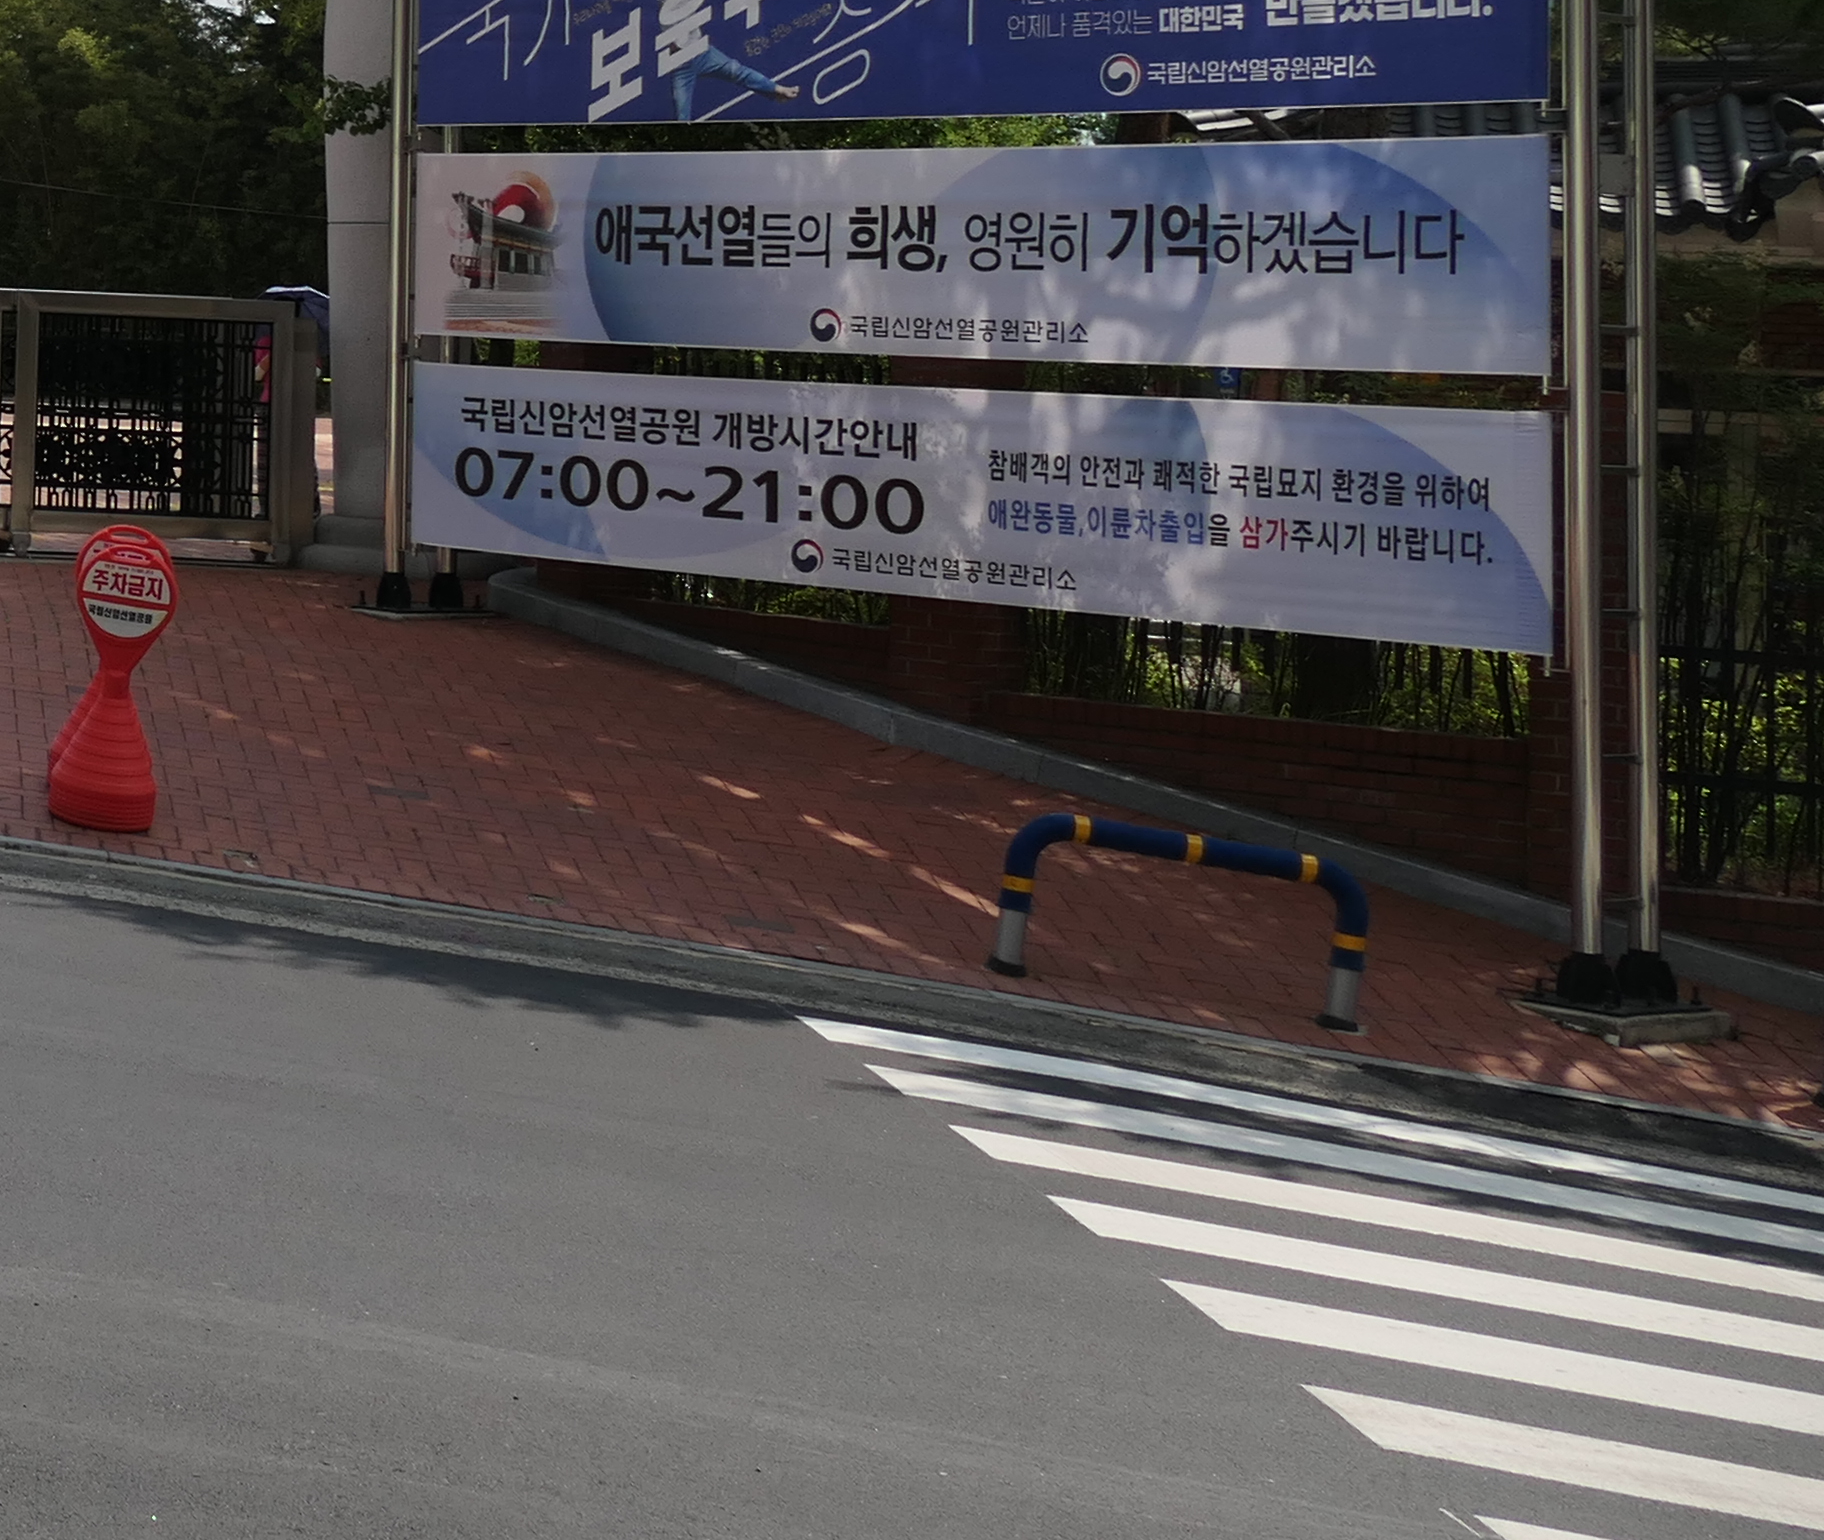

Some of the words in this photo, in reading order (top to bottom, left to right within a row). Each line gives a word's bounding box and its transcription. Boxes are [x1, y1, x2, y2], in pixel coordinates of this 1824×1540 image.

[1007, 13, 1066, 41] 언제나
[1071, 9, 1152, 39] 품격있는
[1157, 3, 1245, 34] 대한민국
[1147, 54, 1377, 85] 국립신암선열공원관리소
[595, 204, 831, 269] 애국선열들의
[846, 204, 949, 273] 희생,
[964, 211, 1089, 272] 영원히
[1106, 203, 1465, 275] 기억하겠습니다
[850, 315, 1090, 345] 국립신암선열공원관리소
[461, 396, 701, 448] 국립신암선열공원
[712, 413, 919, 462] 개방시간안내
[454, 447, 926, 535] 07:00~21:00
[987, 448, 1071, 486] 참배객의
[1080, 454, 1146, 491] 안전과
[1153, 459, 1221, 495] 쾌적한
[1228, 463, 1322, 502] 국립묘지
[1331, 468, 1405, 508] 환경을
[1415, 472, 1490, 513] 위하여
[1239, 515, 1366, 558] 삼가주시기
[1377, 524, 1494, 566] 바랍니다.
[92, 569, 163, 600] 주차금지
[832, 547, 1077, 591] 국립신암선열공원관리소
